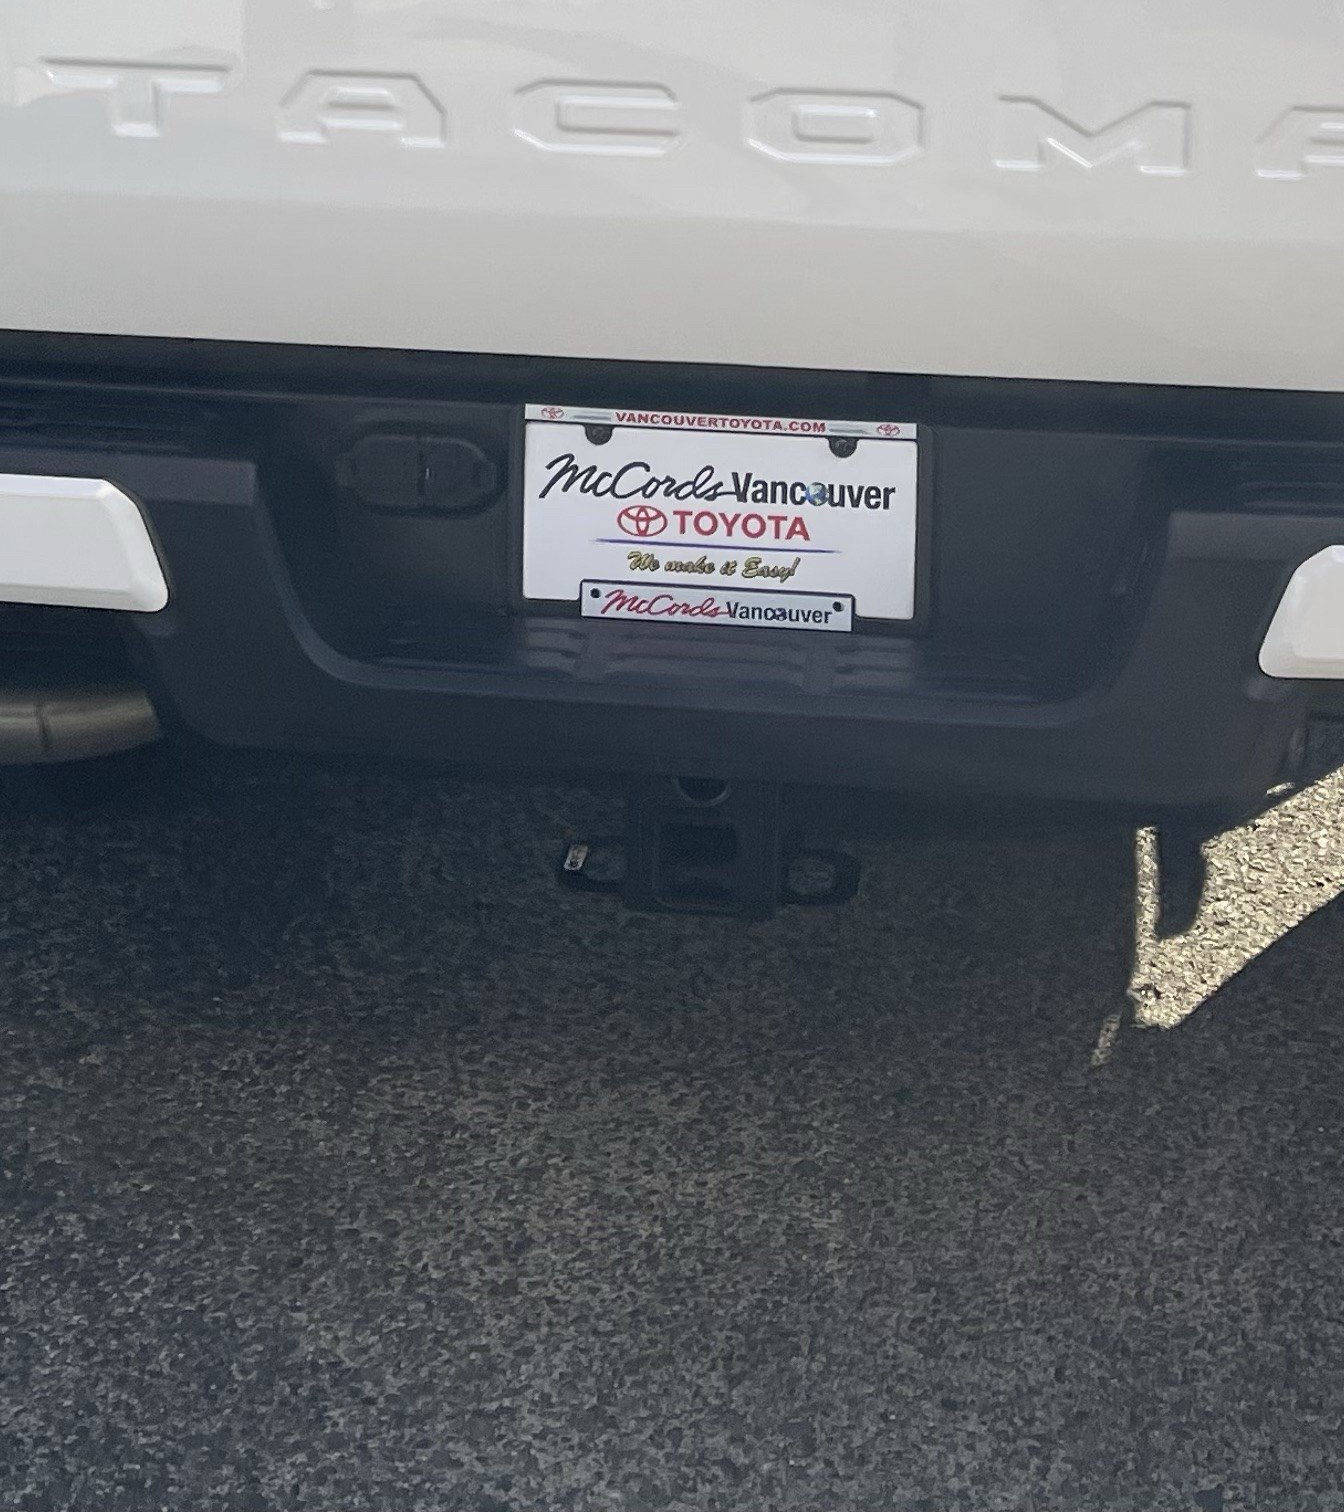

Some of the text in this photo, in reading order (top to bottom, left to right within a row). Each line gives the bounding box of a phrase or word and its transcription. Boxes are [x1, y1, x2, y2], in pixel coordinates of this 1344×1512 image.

[614, 411, 827, 434] VANCOUVERTOYOTA.COM
[538, 452, 897, 510] McCords Vancouver
[673, 510, 812, 542] TOYOTA
[626, 550, 803, 584] We make it Easy!
[600, 588, 730, 620] McCords
